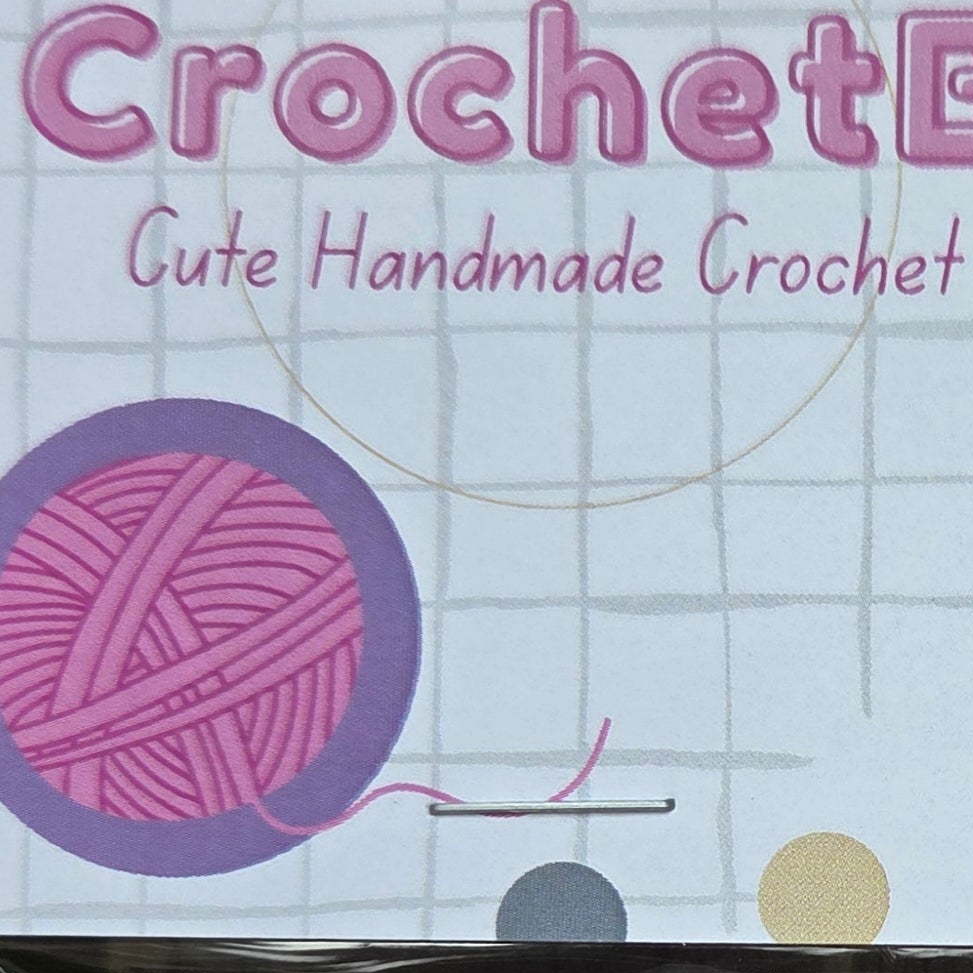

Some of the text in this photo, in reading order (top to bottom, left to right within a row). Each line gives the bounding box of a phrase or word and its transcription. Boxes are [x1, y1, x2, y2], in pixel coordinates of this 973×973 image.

[128, 206, 279, 291] Cute
[310, 211, 664, 294] Handmade
[699, 213, 963, 297] Crochet
